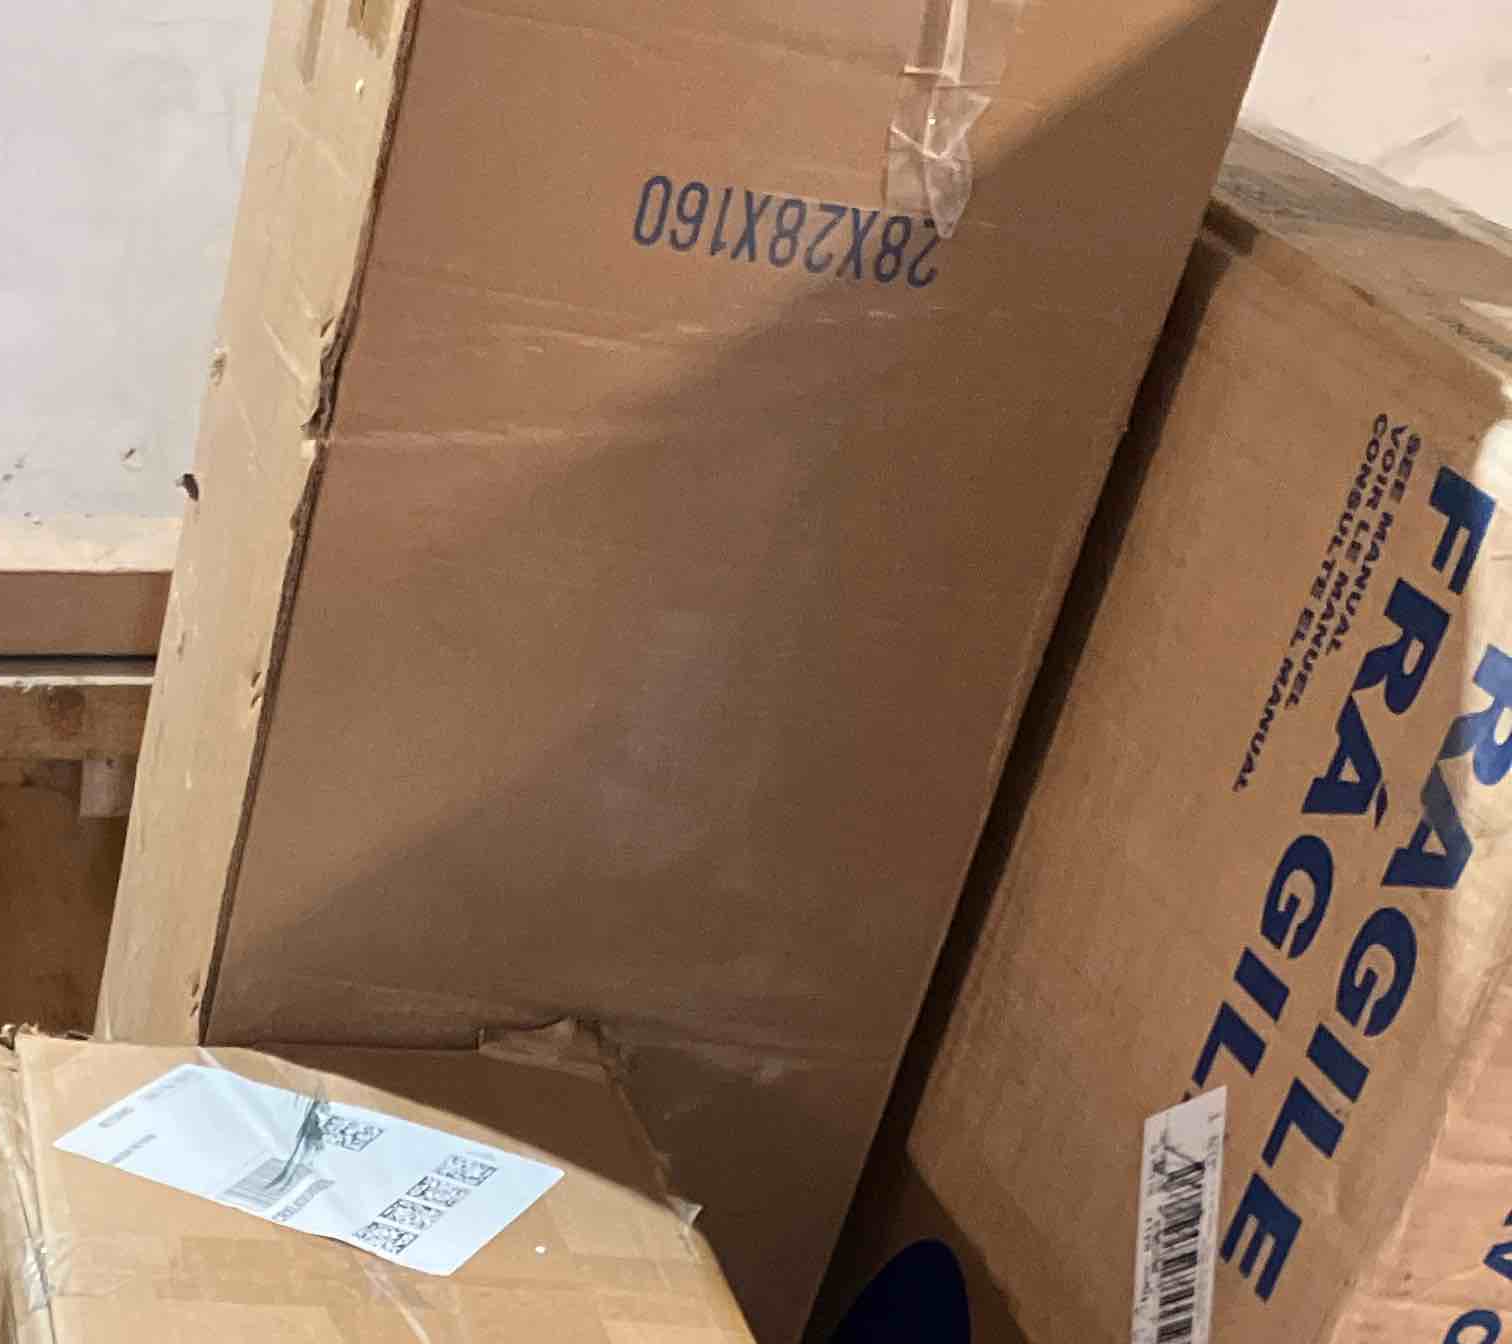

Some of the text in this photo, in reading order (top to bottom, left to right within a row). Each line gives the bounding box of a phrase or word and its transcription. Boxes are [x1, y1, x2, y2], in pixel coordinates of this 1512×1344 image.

[633, 175, 942, 288] 28X28X160
[1233, 413, 1388, 792] CONSULTE EL MANUAL
[1285, 424, 1408, 710] VOIR LE MANUEL
[1326, 433, 1421, 656] SEE MANUAL
[1187, 464, 1498, 1096] FRÁGIL
